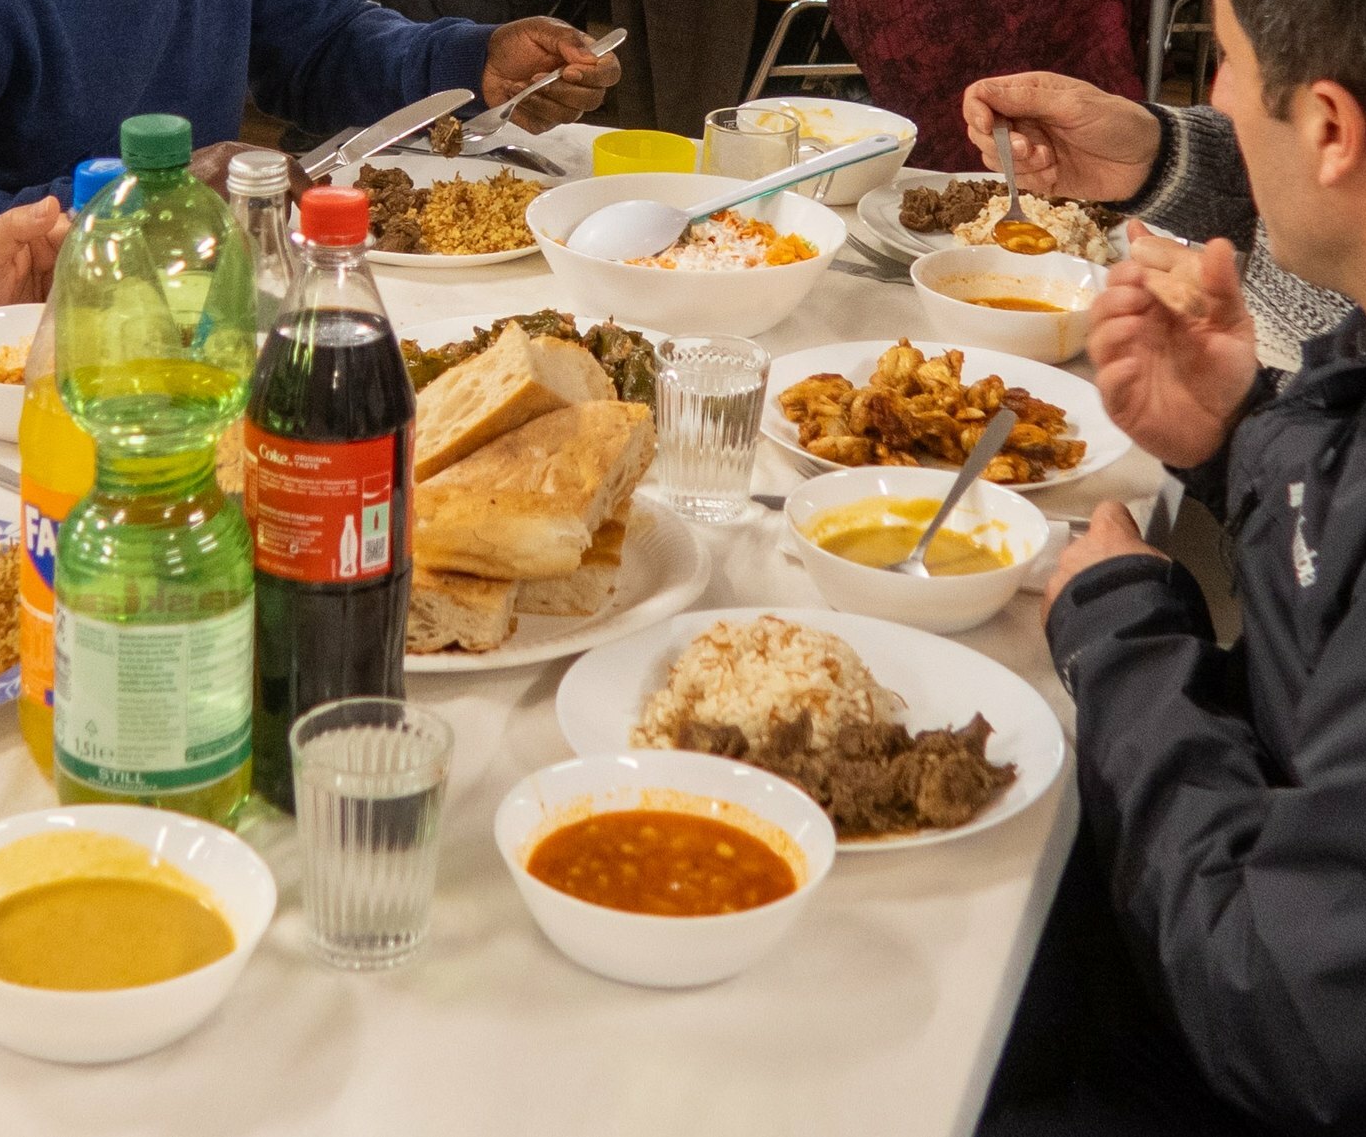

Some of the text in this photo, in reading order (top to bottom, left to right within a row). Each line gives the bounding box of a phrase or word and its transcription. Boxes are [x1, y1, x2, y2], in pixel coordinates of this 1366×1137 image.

[258, 443, 288, 464] Coke
[294, 454, 332, 464] ORIGINAL
[295, 462, 320, 470] TASTE
[25, 504, 60, 557] FA
[98, 767, 143, 784] STILL
